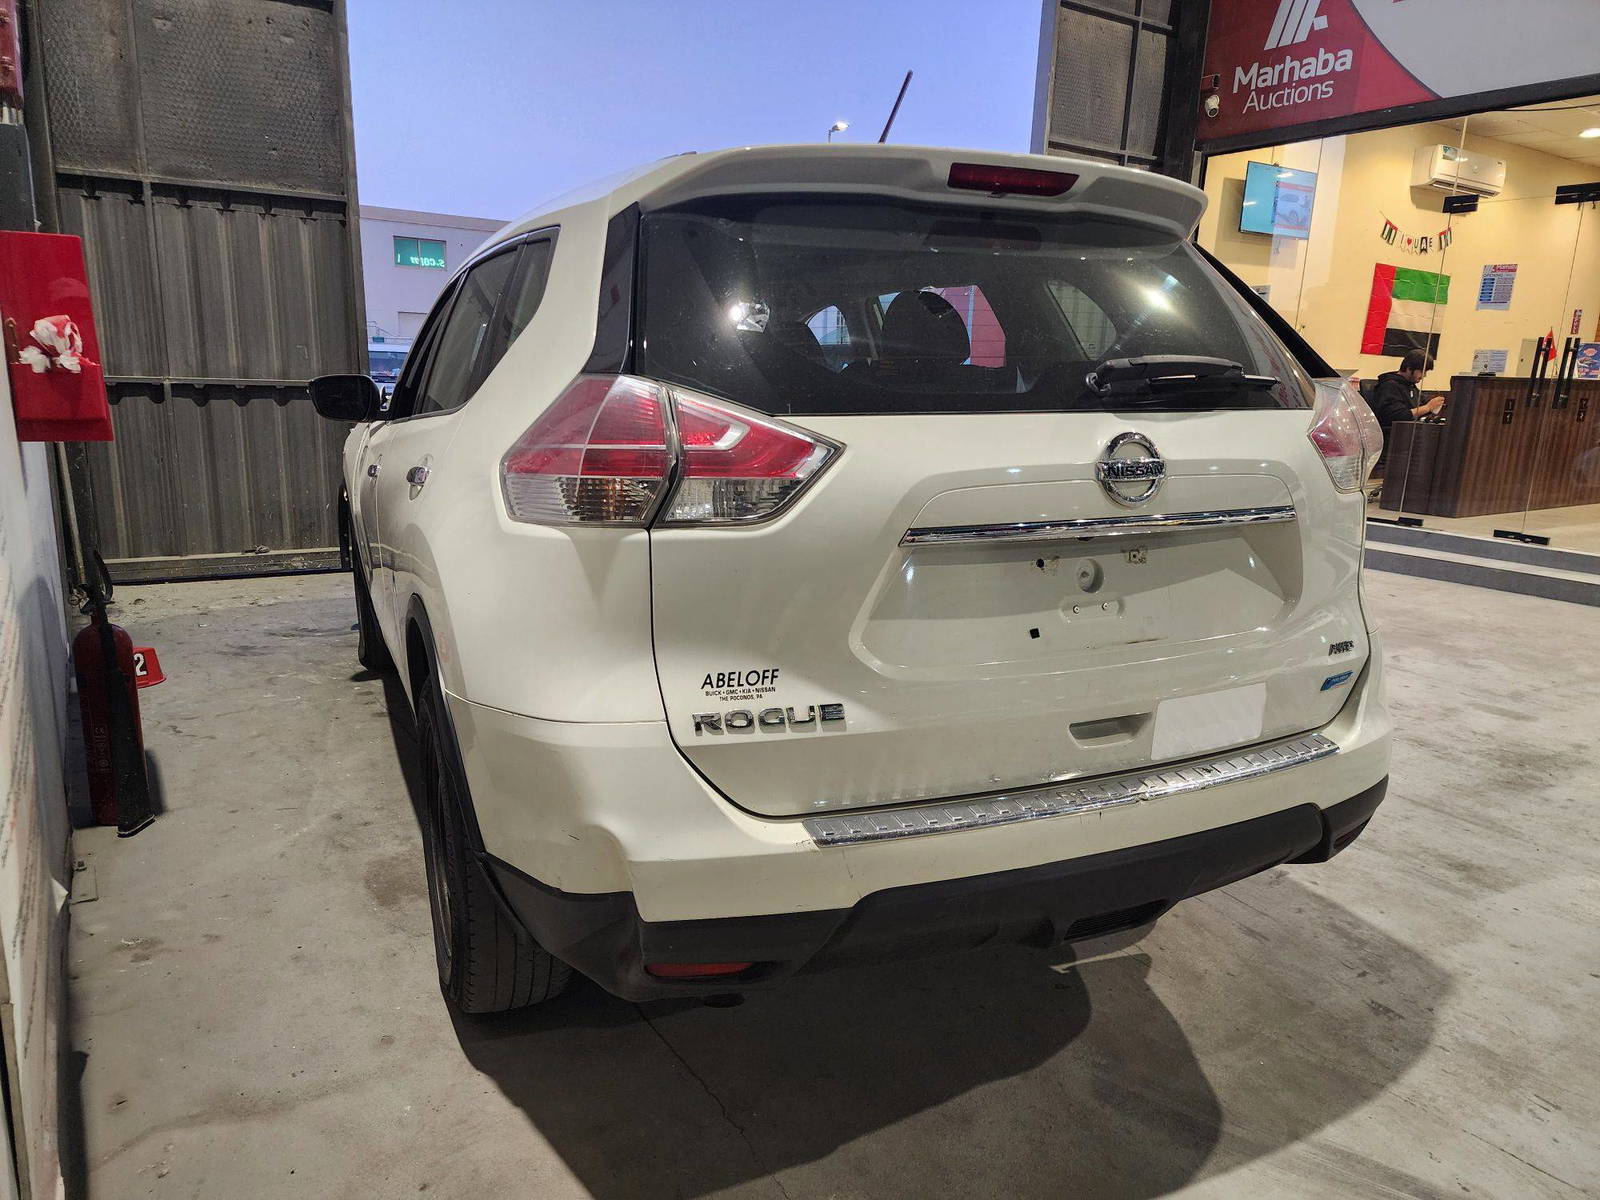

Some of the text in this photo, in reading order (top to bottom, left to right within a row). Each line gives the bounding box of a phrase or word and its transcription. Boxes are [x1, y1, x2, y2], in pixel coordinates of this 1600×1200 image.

[1233, 48, 1353, 94] Marhaba
[1242, 80, 1335, 114] Auctions
[1107, 462, 1163, 476] NISSAN
[134, 653, 148, 676] 2
[701, 669, 779, 690] ABELOFF
[692, 703, 845, 733] ROGUE
